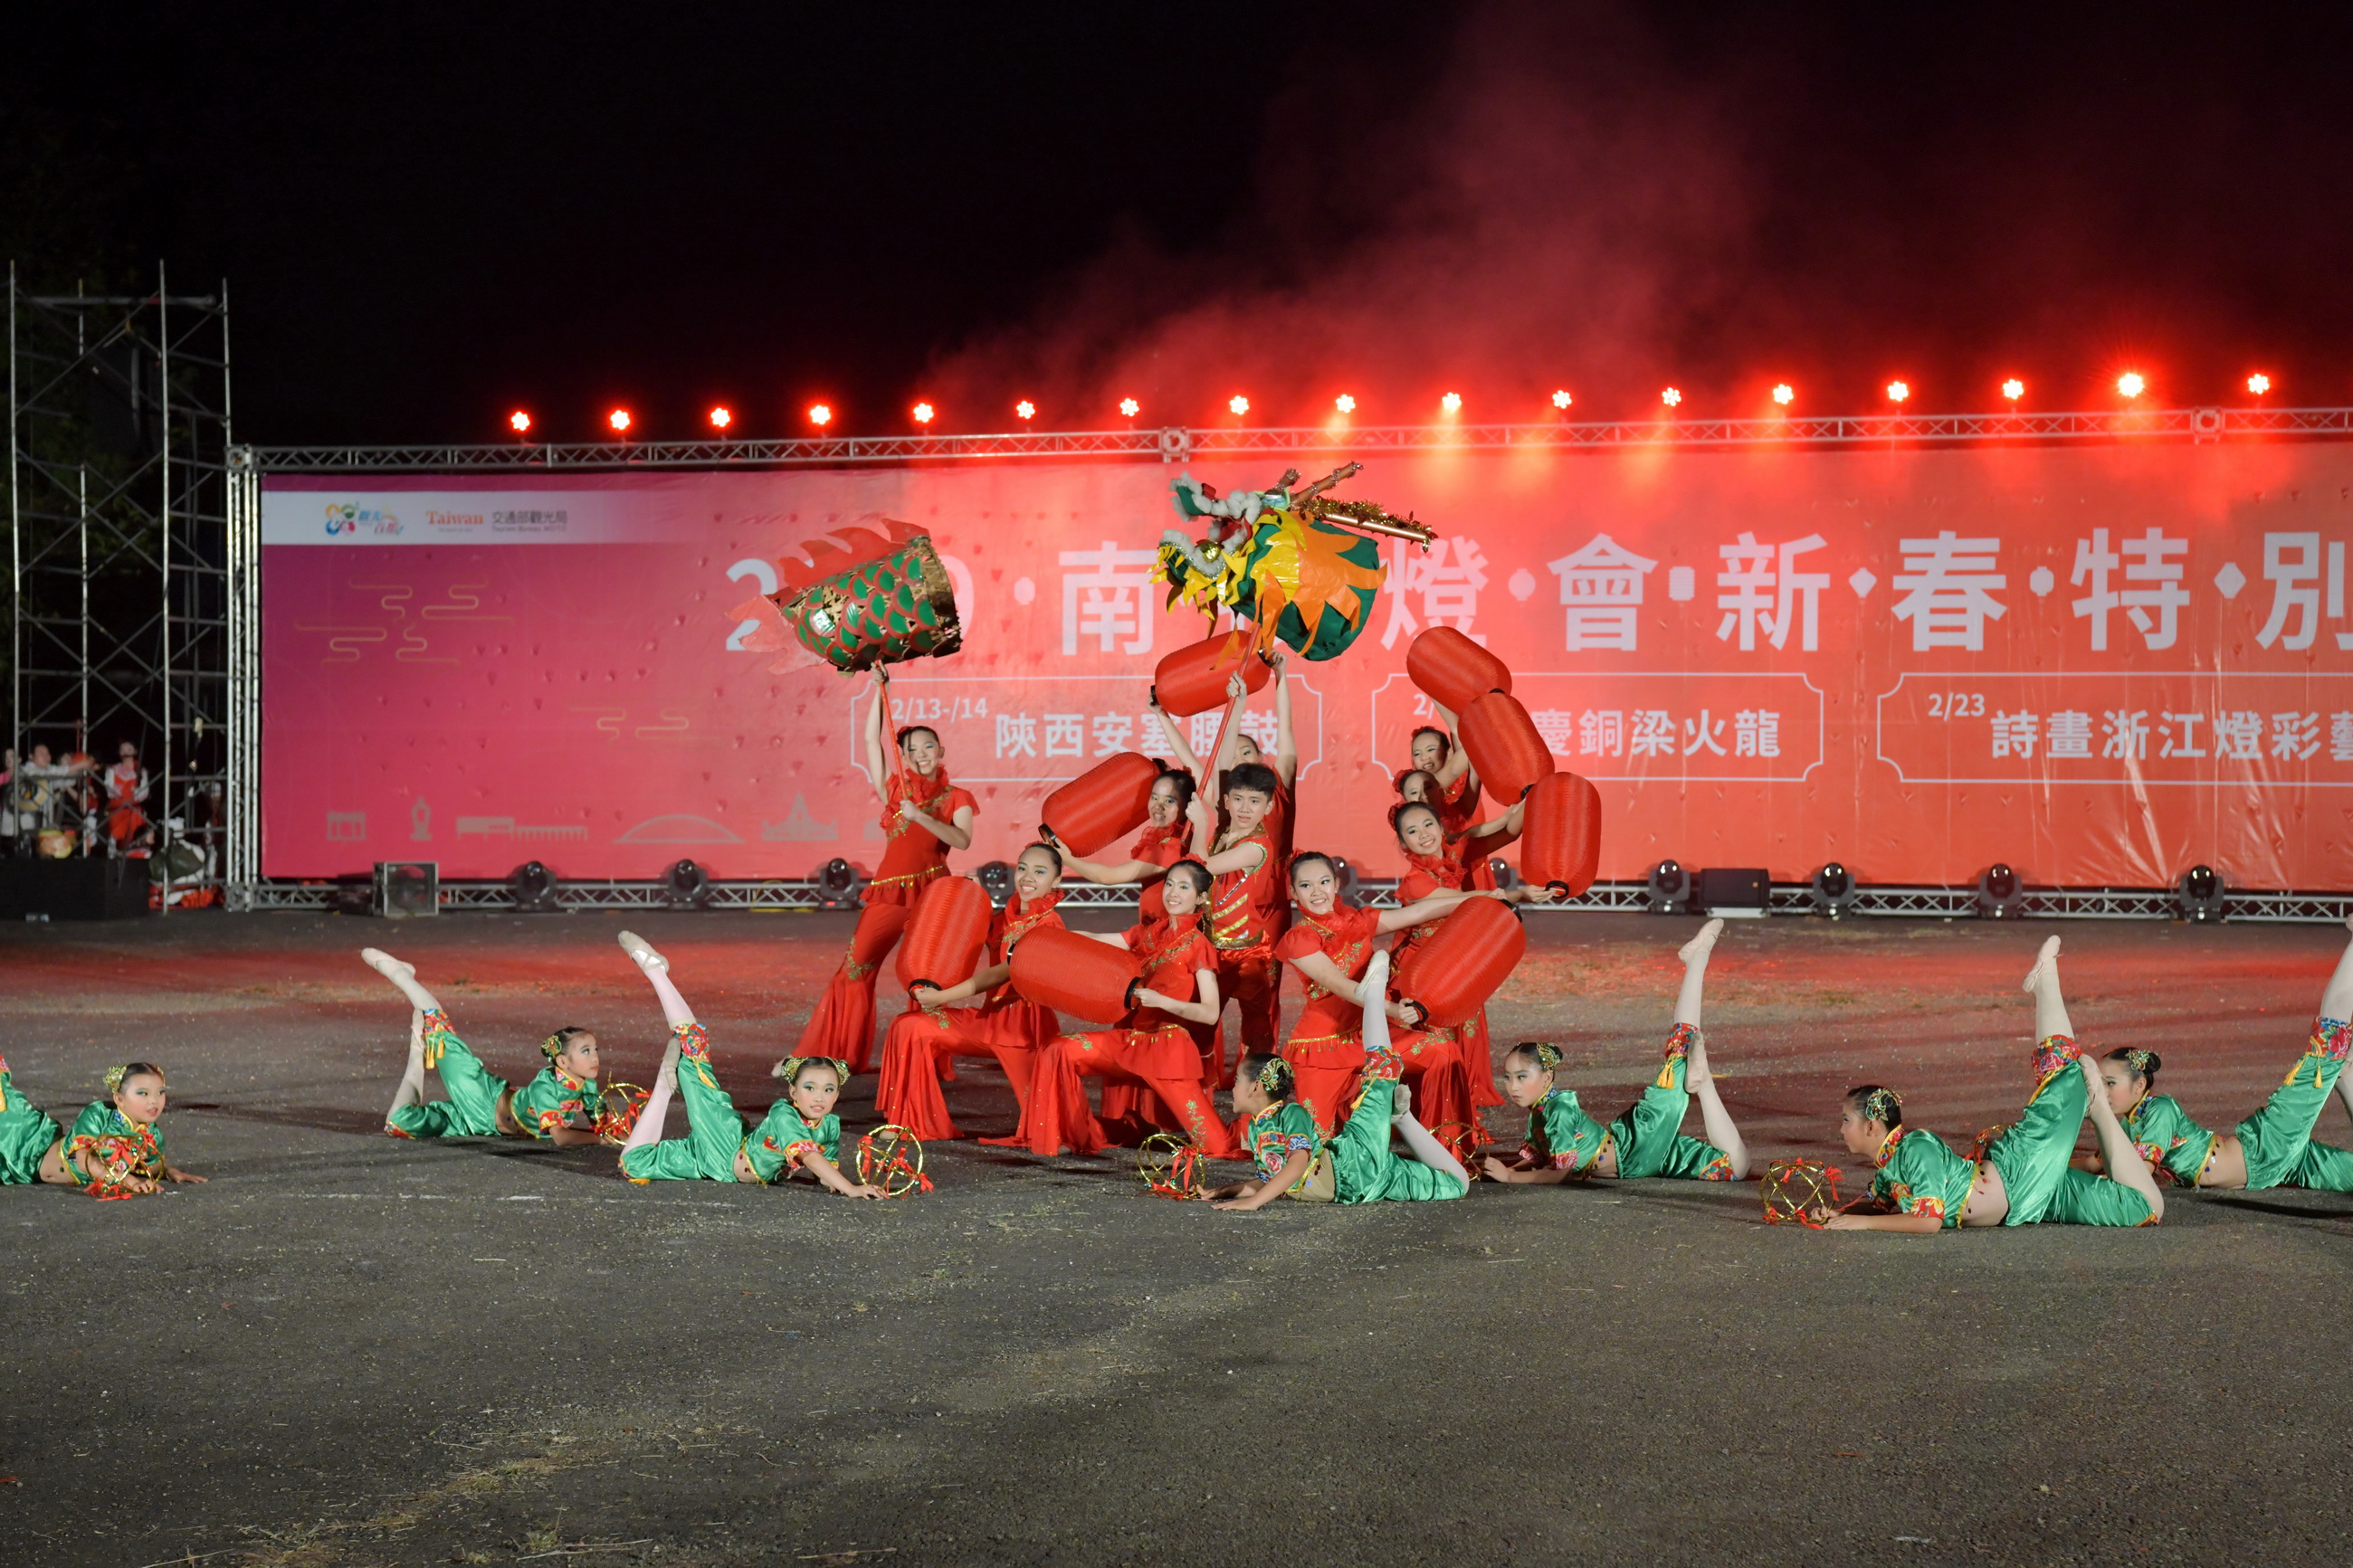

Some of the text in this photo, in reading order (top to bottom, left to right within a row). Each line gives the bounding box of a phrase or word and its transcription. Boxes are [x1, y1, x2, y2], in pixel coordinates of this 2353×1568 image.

[426, 510, 483, 525] Taiwan
[492, 510, 567, 525] 交通部觀光局
[891, 697, 987, 724] 2/13-/14
[1929, 692, 1986, 721] 2/23
[1531, 708, 1781, 758] 慶銅梁火龍
